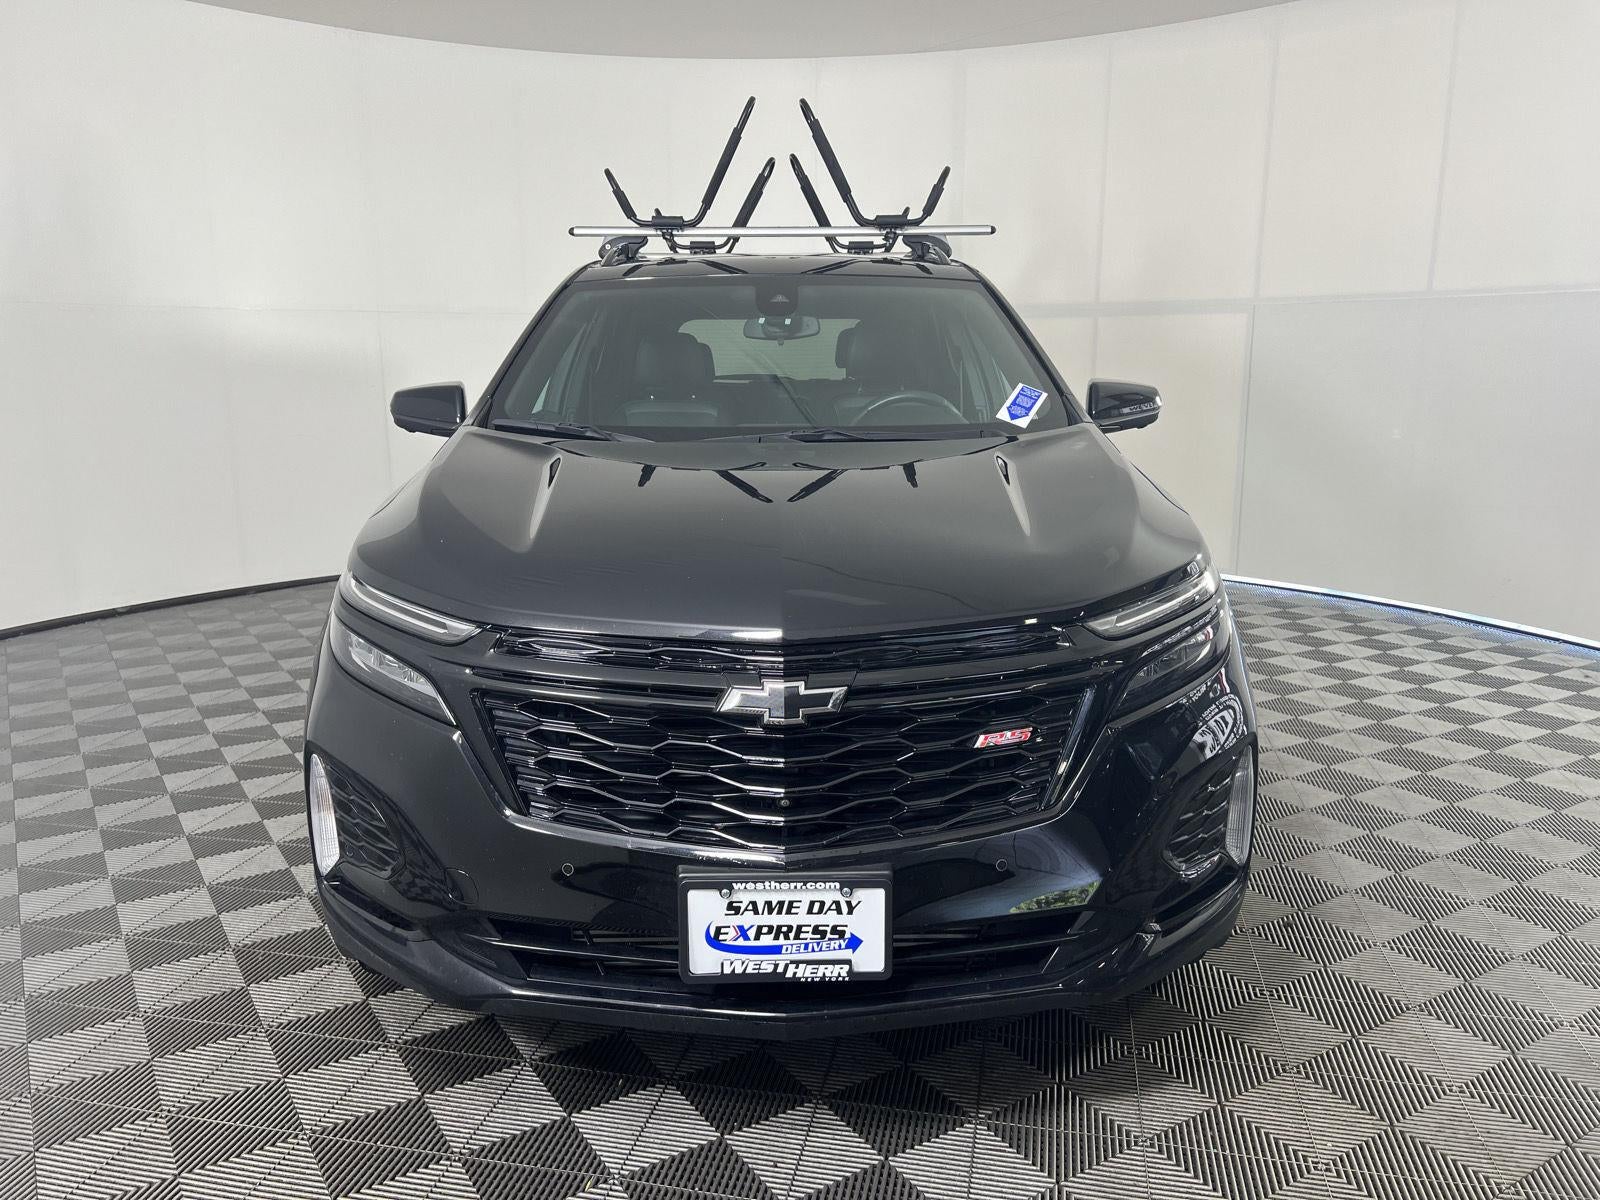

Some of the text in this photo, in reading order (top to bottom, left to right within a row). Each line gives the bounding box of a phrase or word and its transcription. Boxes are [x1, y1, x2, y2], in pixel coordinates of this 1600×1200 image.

[732, 881, 840, 890] westherr.com
[725, 900, 862, 916] SAME DAY
[713, 924, 848, 942] EXPRESS
[781, 939, 849, 955] DELIVERY
